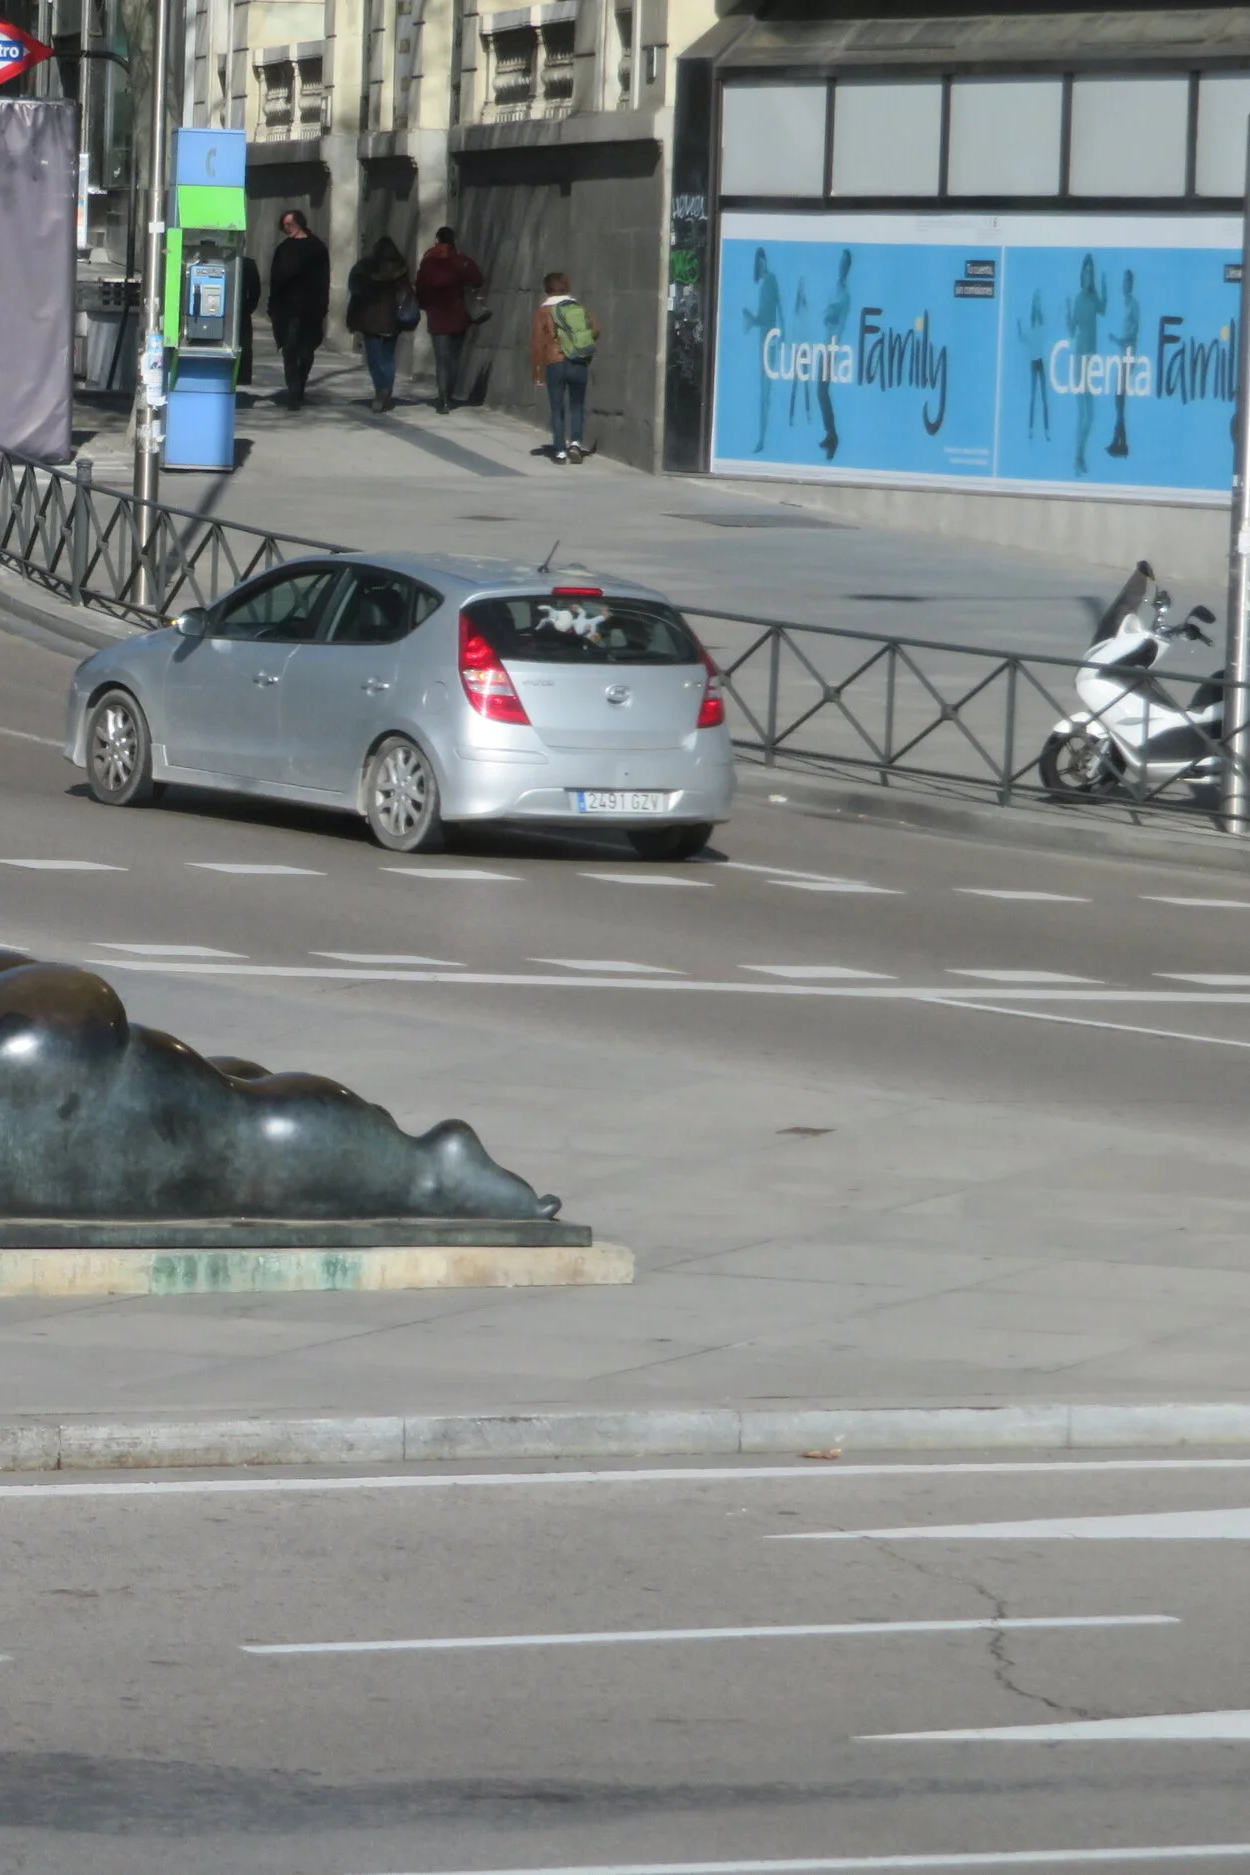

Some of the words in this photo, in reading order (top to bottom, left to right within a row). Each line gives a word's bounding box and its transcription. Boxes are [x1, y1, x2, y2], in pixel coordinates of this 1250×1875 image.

[763, 327, 853, 383] Cuenta
[857, 307, 947, 436] Family
[1050, 339, 1151, 396] Cuenta
[1156, 316, 1240, 440] Famil
[588, 793, 625, 809] 2491
[631, 794, 659, 810] GZV
